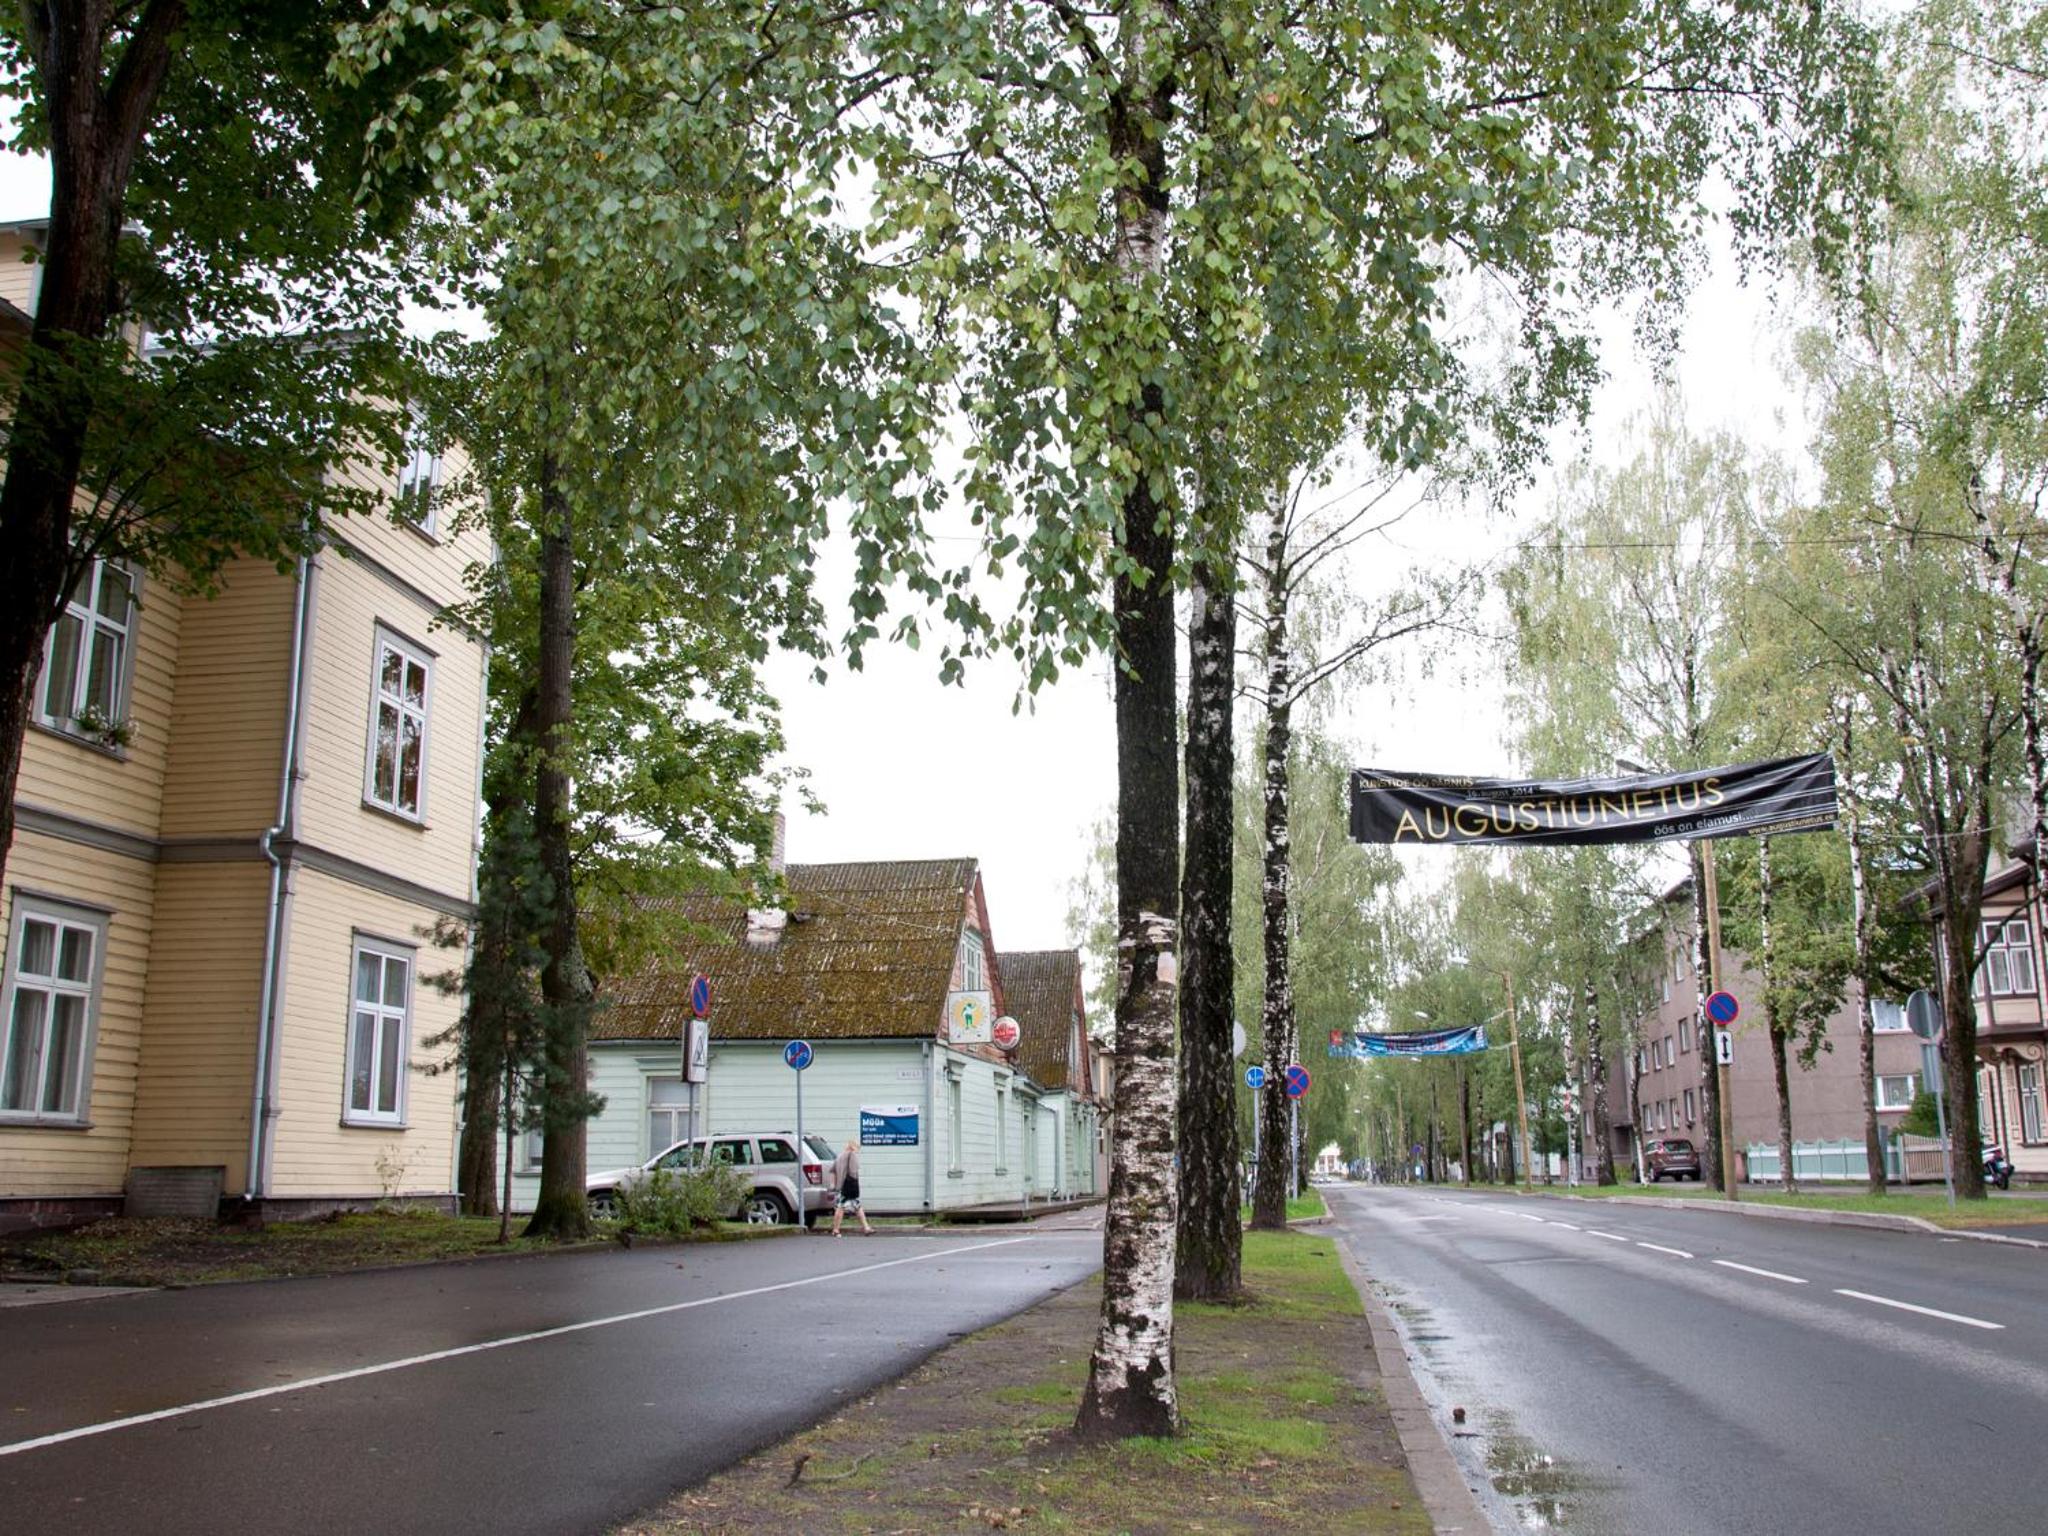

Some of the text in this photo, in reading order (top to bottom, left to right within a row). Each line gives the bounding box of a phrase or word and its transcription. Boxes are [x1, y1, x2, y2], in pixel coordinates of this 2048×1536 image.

[1511, 785, 1534, 796] 2014
[1393, 777, 1725, 842] AUGUSTIUNETUS
[1678, 822, 1693, 832] on
